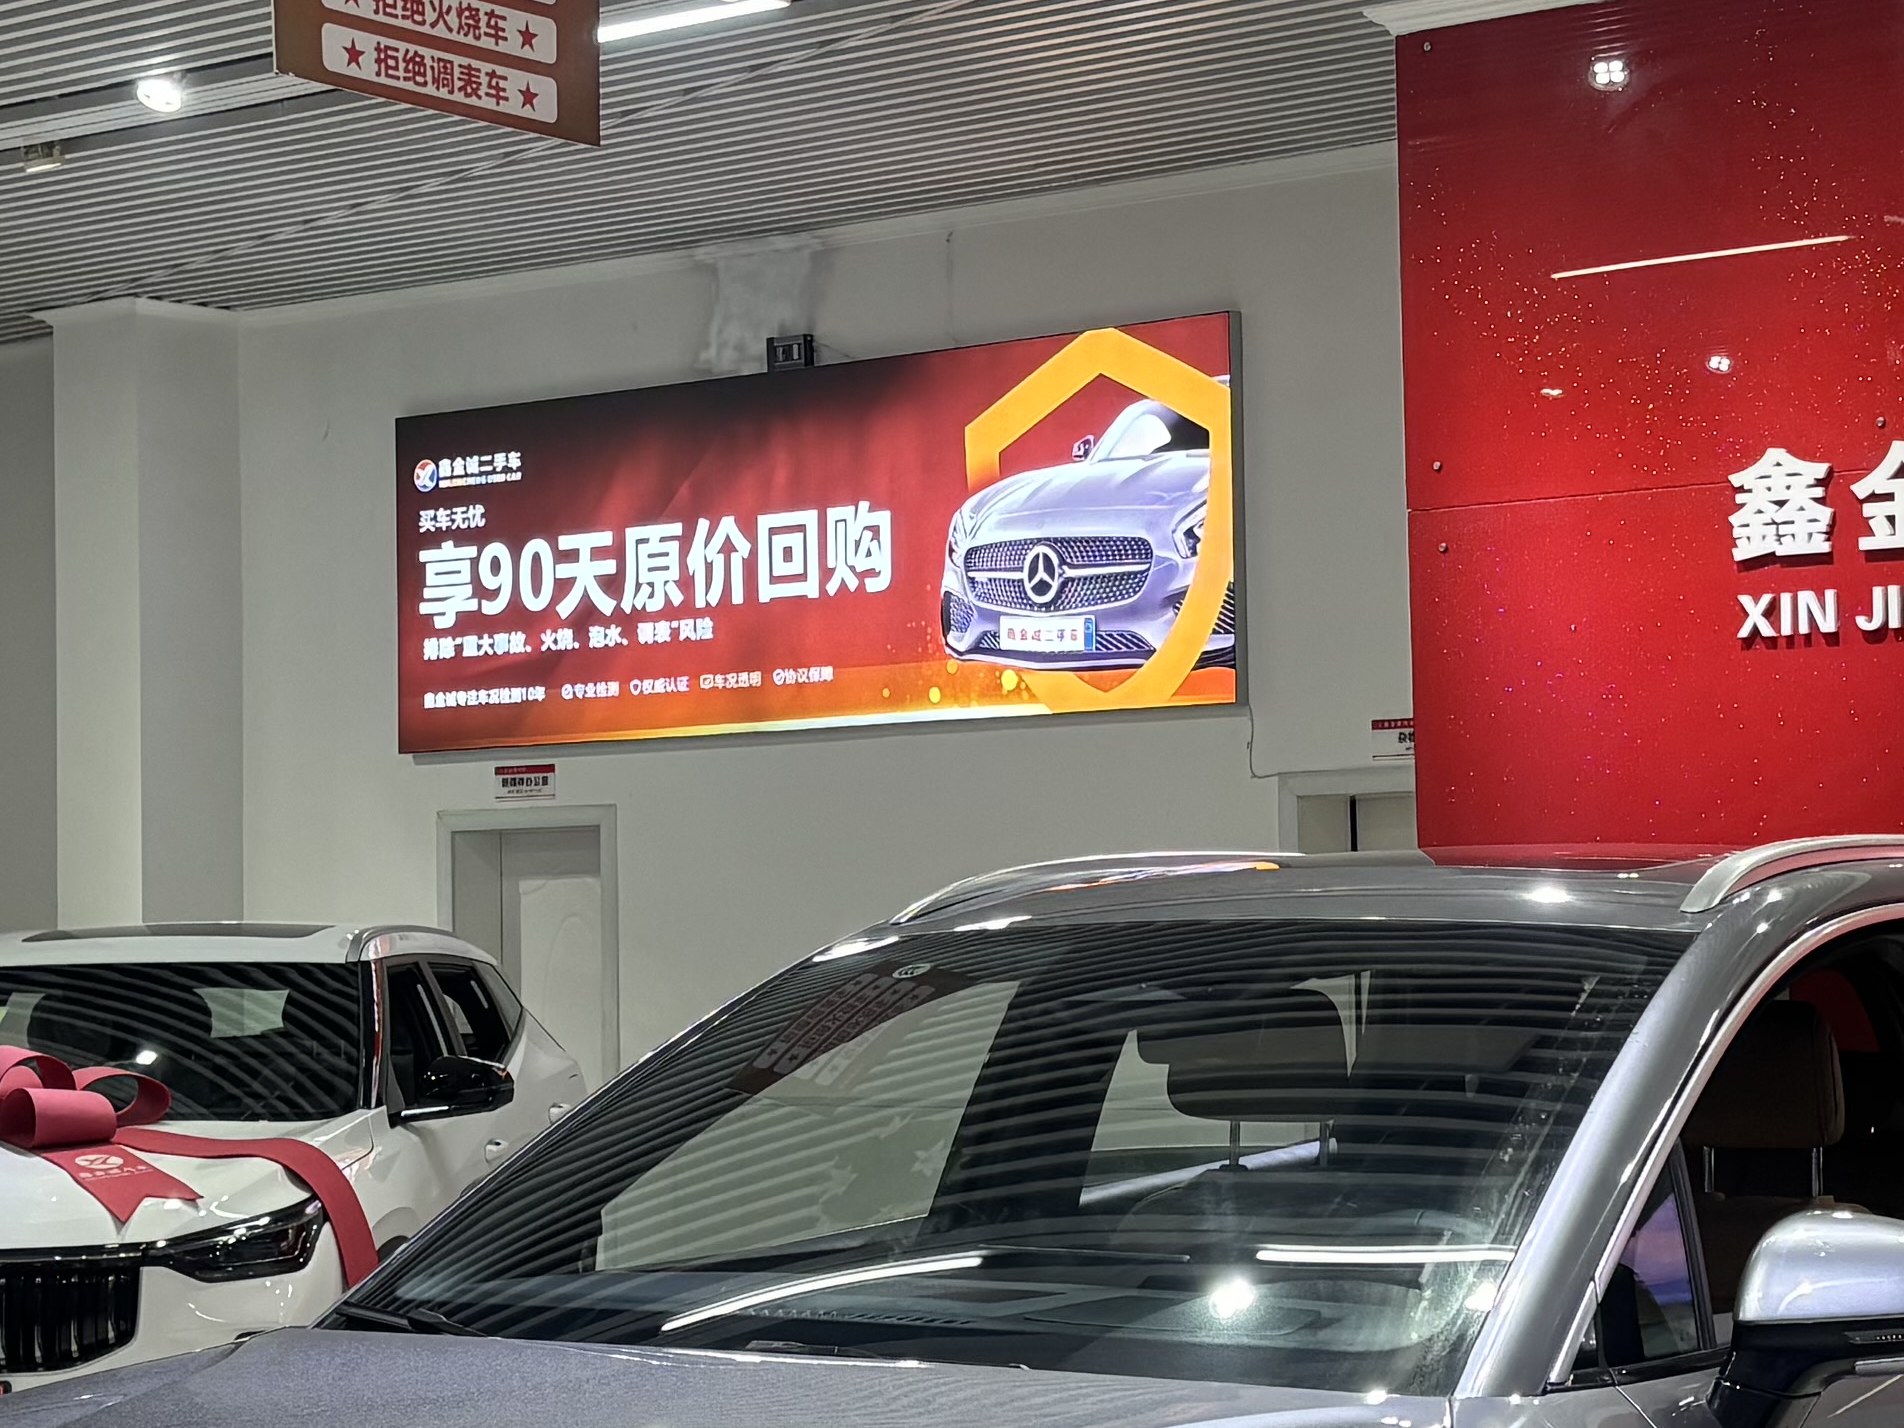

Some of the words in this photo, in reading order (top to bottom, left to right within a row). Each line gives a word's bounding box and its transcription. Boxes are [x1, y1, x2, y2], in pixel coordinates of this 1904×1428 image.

[373, 40, 510, 107] 拒绝调表车
[438, 451, 522, 477] 鑫金诚二手车
[419, 504, 486, 534] 买车无忧
[418, 500, 893, 630] 享90天原价回购
[1736, 588, 1838, 639] XIN
[574, 680, 620, 699] 专业检测
[642, 675, 690, 695] 权威认证
[713, 670, 762, 690] 车况透明
